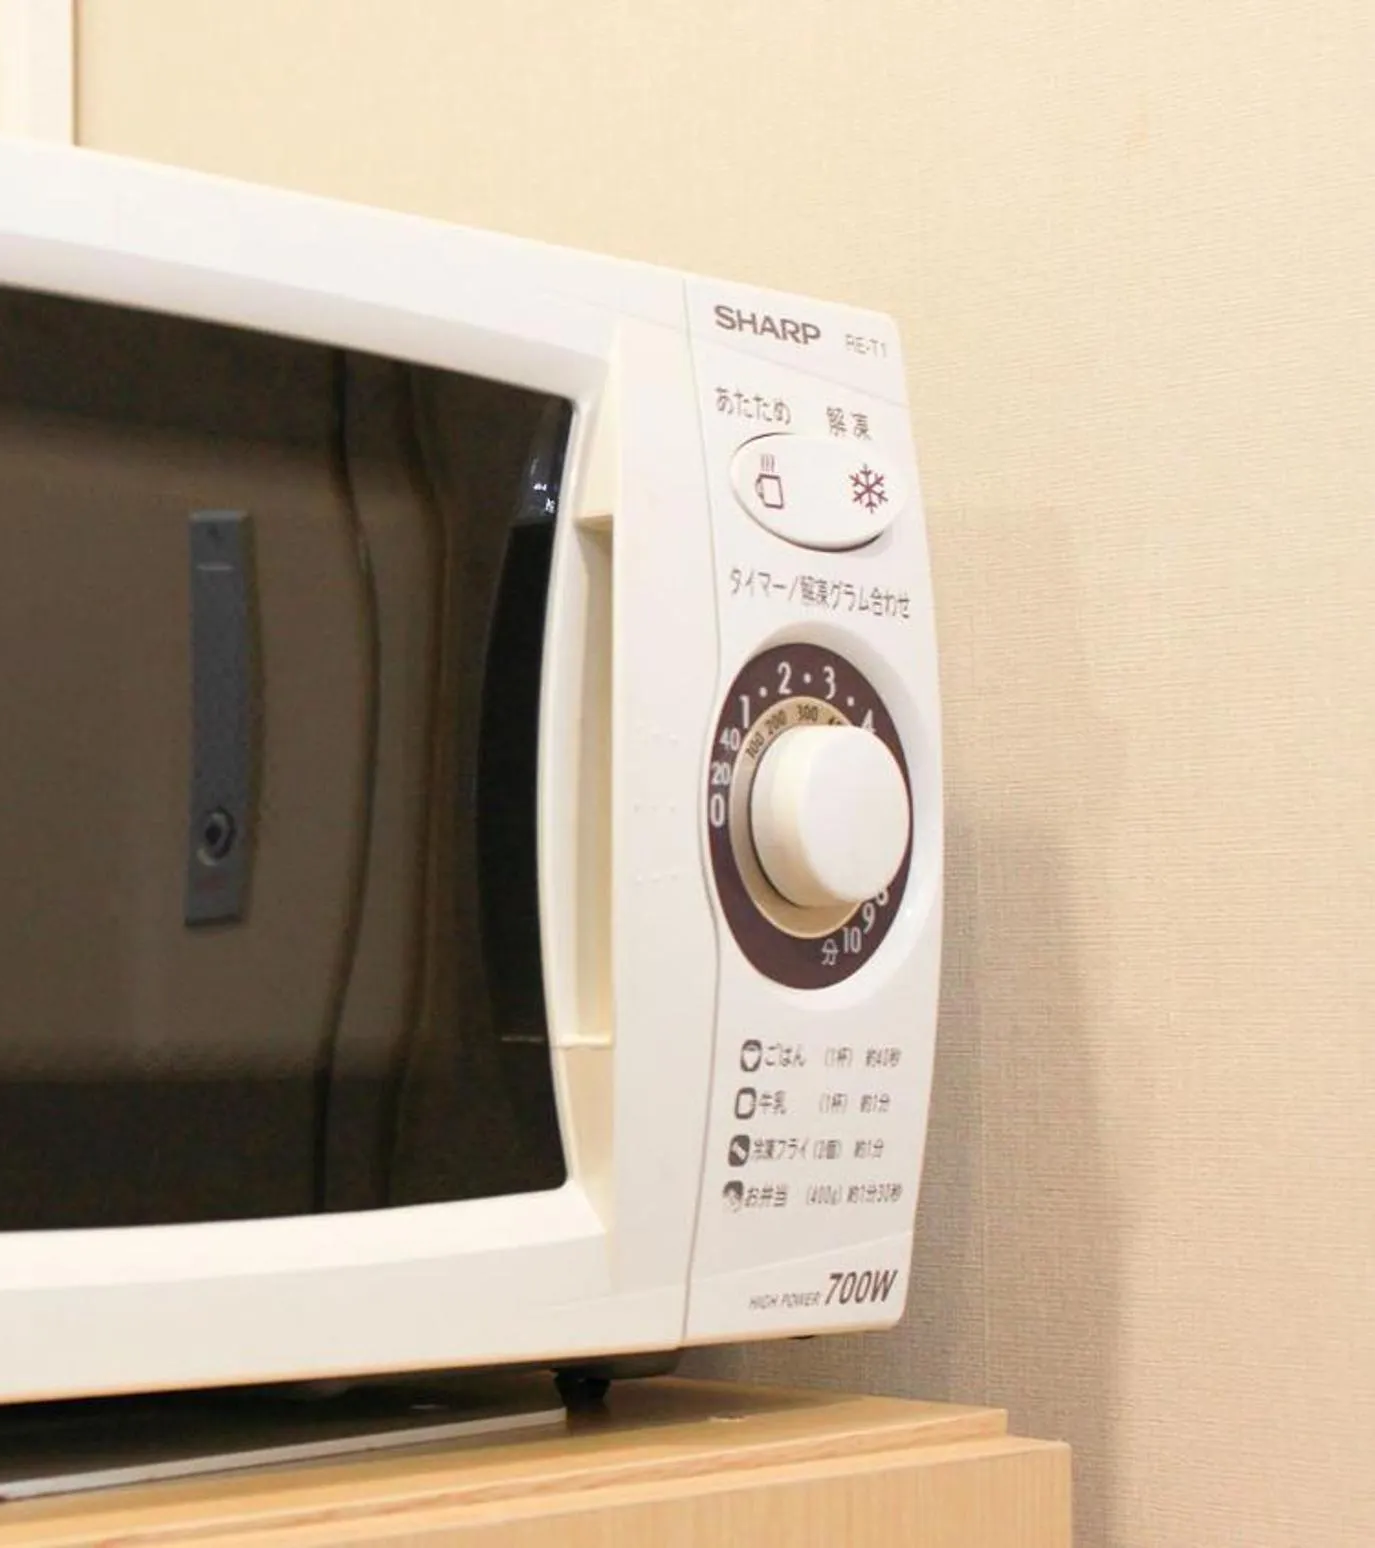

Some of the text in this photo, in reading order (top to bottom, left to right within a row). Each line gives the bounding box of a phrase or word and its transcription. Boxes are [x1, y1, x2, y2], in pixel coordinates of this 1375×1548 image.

[714, 304, 821, 345] SHARP
[715, 386, 872, 440] あたため 解凍
[777, 661, 792, 695] 2
[823, 666, 837, 700] 3
[739, 695, 750, 729] 1
[796, 705, 819, 722] 300
[719, 728, 741, 751] 40
[711, 762, 731, 785] 20
[710, 793, 725, 827] 0
[862, 902, 876, 933] 9
[821, 938, 840, 966] 分
[842, 926, 862, 954] 10
[765, 1043, 806, 1067] ごはん
[745, 1184, 789, 1208] お弁当
[825, 1269, 899, 1305] 700W
